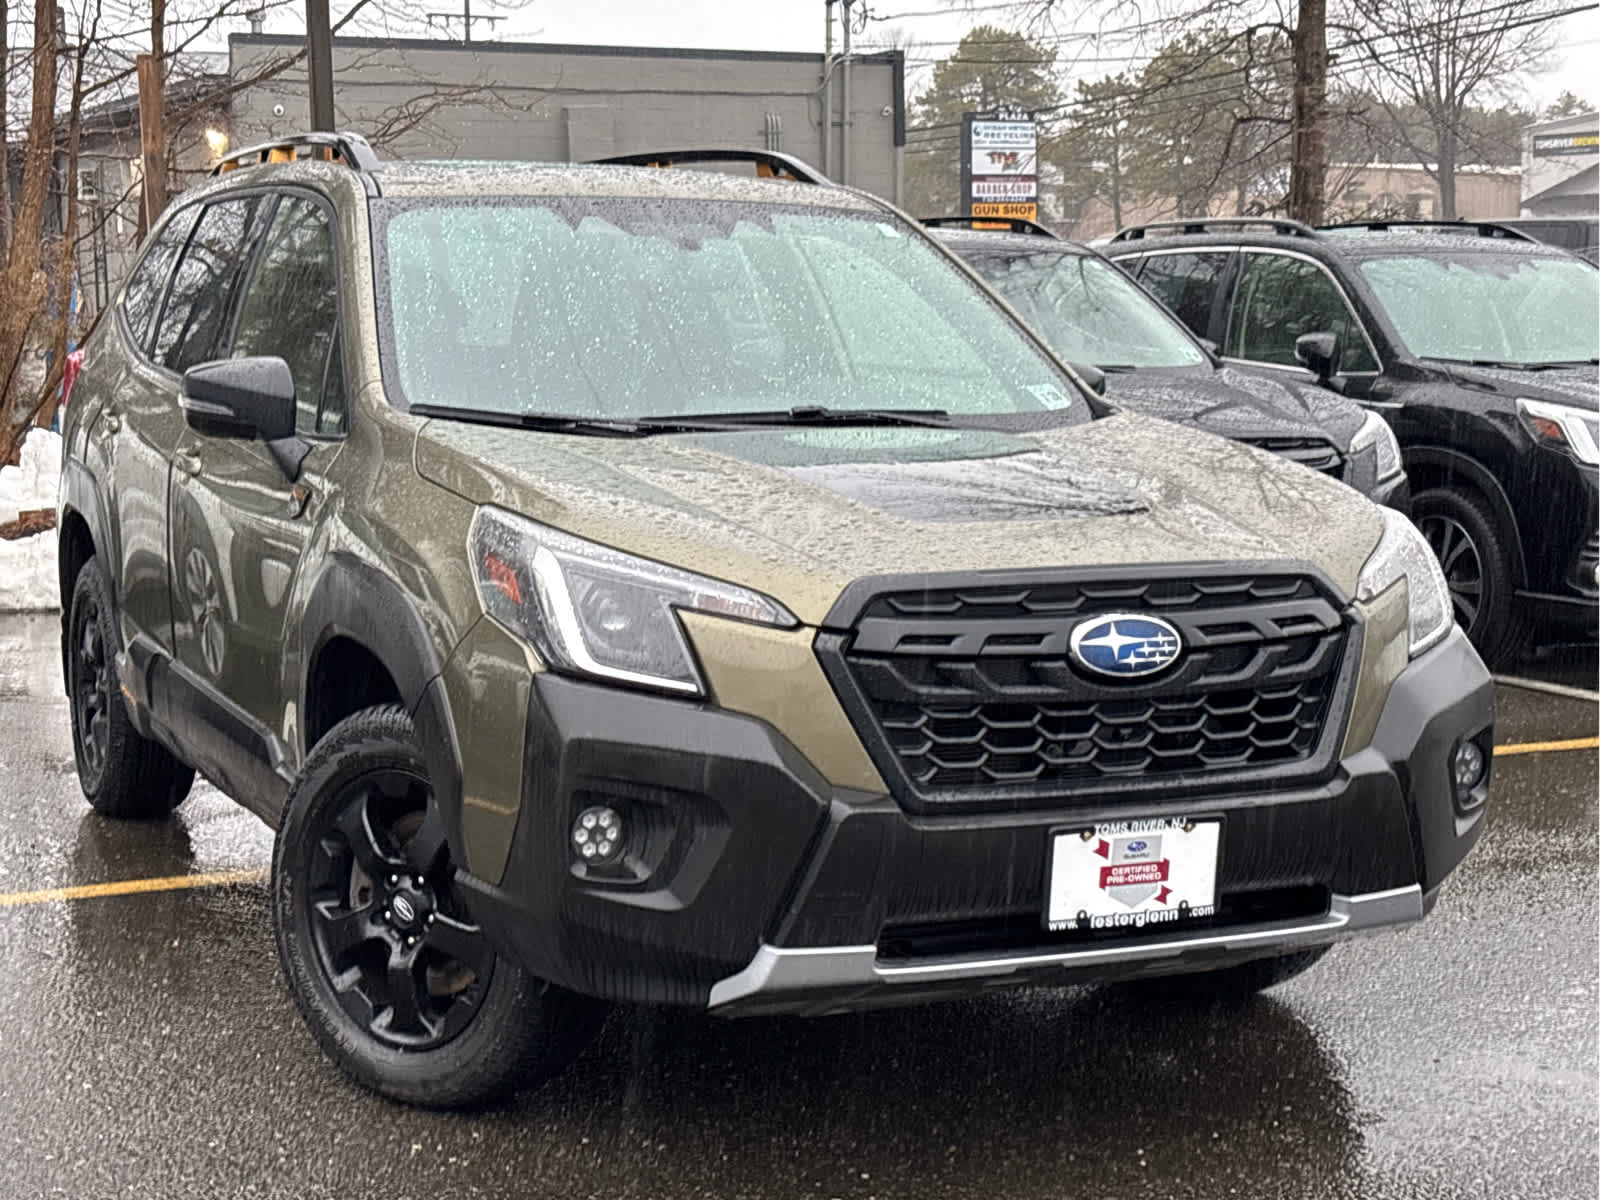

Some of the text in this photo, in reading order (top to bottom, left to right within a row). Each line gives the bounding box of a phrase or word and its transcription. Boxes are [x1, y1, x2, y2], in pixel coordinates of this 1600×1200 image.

[998, 112, 1029, 120] PLAZA
[974, 205, 1034, 215] GUN SHOP
[1094, 821, 1128, 834] TOMS
[1171, 817, 1187, 829] NJ
[1111, 864, 1158, 876] CERTIFIED
[1106, 872, 1162, 884] PRE-OWNED
